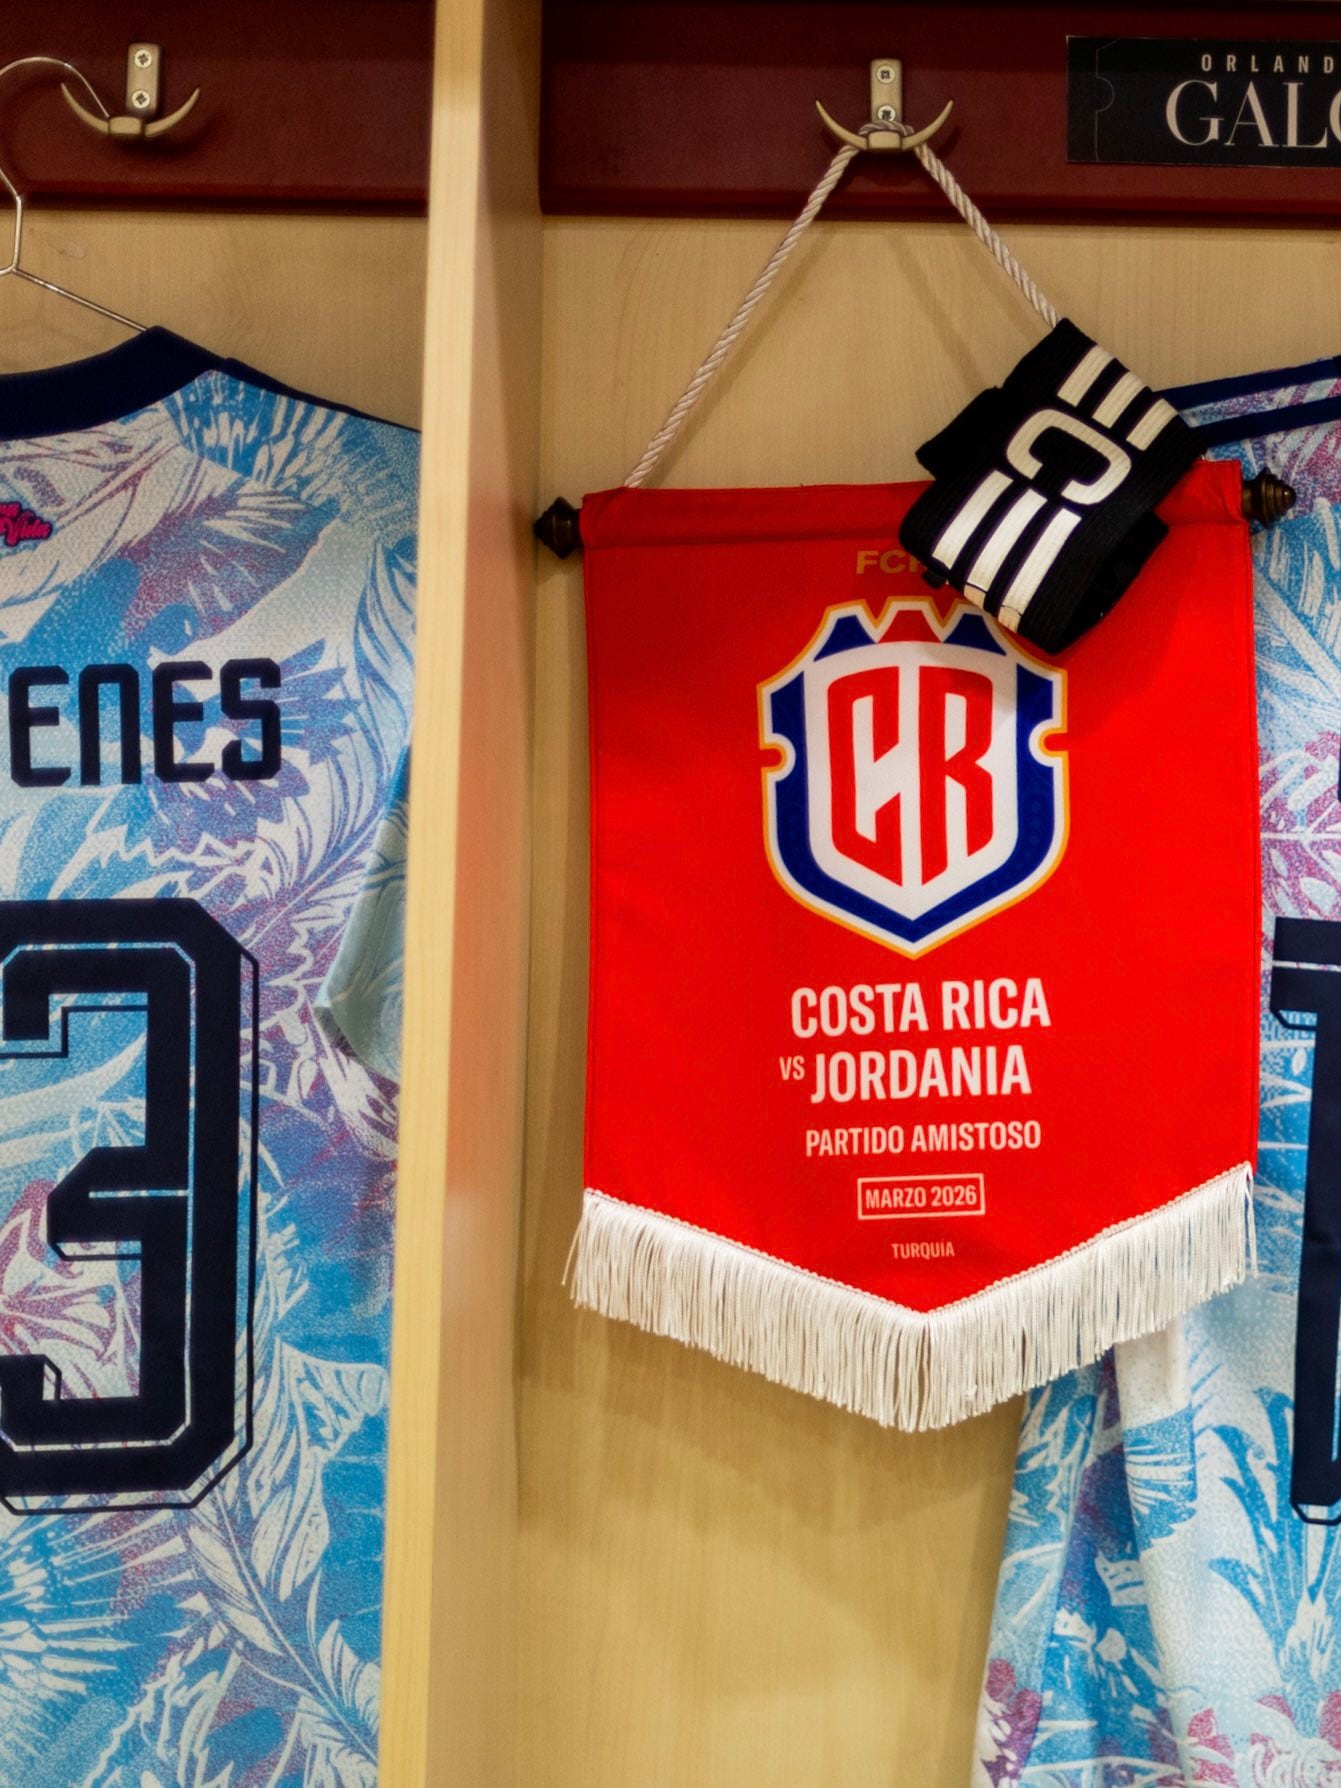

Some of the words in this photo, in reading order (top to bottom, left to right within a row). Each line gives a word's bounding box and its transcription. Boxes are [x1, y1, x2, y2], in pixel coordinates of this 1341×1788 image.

[8, 657, 282, 788] ENES
[827, 665, 995, 888] CR
[790, 982, 929, 1038] COSTA
[941, 977, 1052, 1031] RICA
[778, 1055, 806, 1081] VS
[810, 1044, 1033, 1104] JORDANIA
[805, 1124, 905, 1157] PARTIDO
[910, 1120, 1042, 1153] AMISTOSO
[864, 1186, 927, 1209] MARZO
[931, 1183, 978, 1207] 2026
